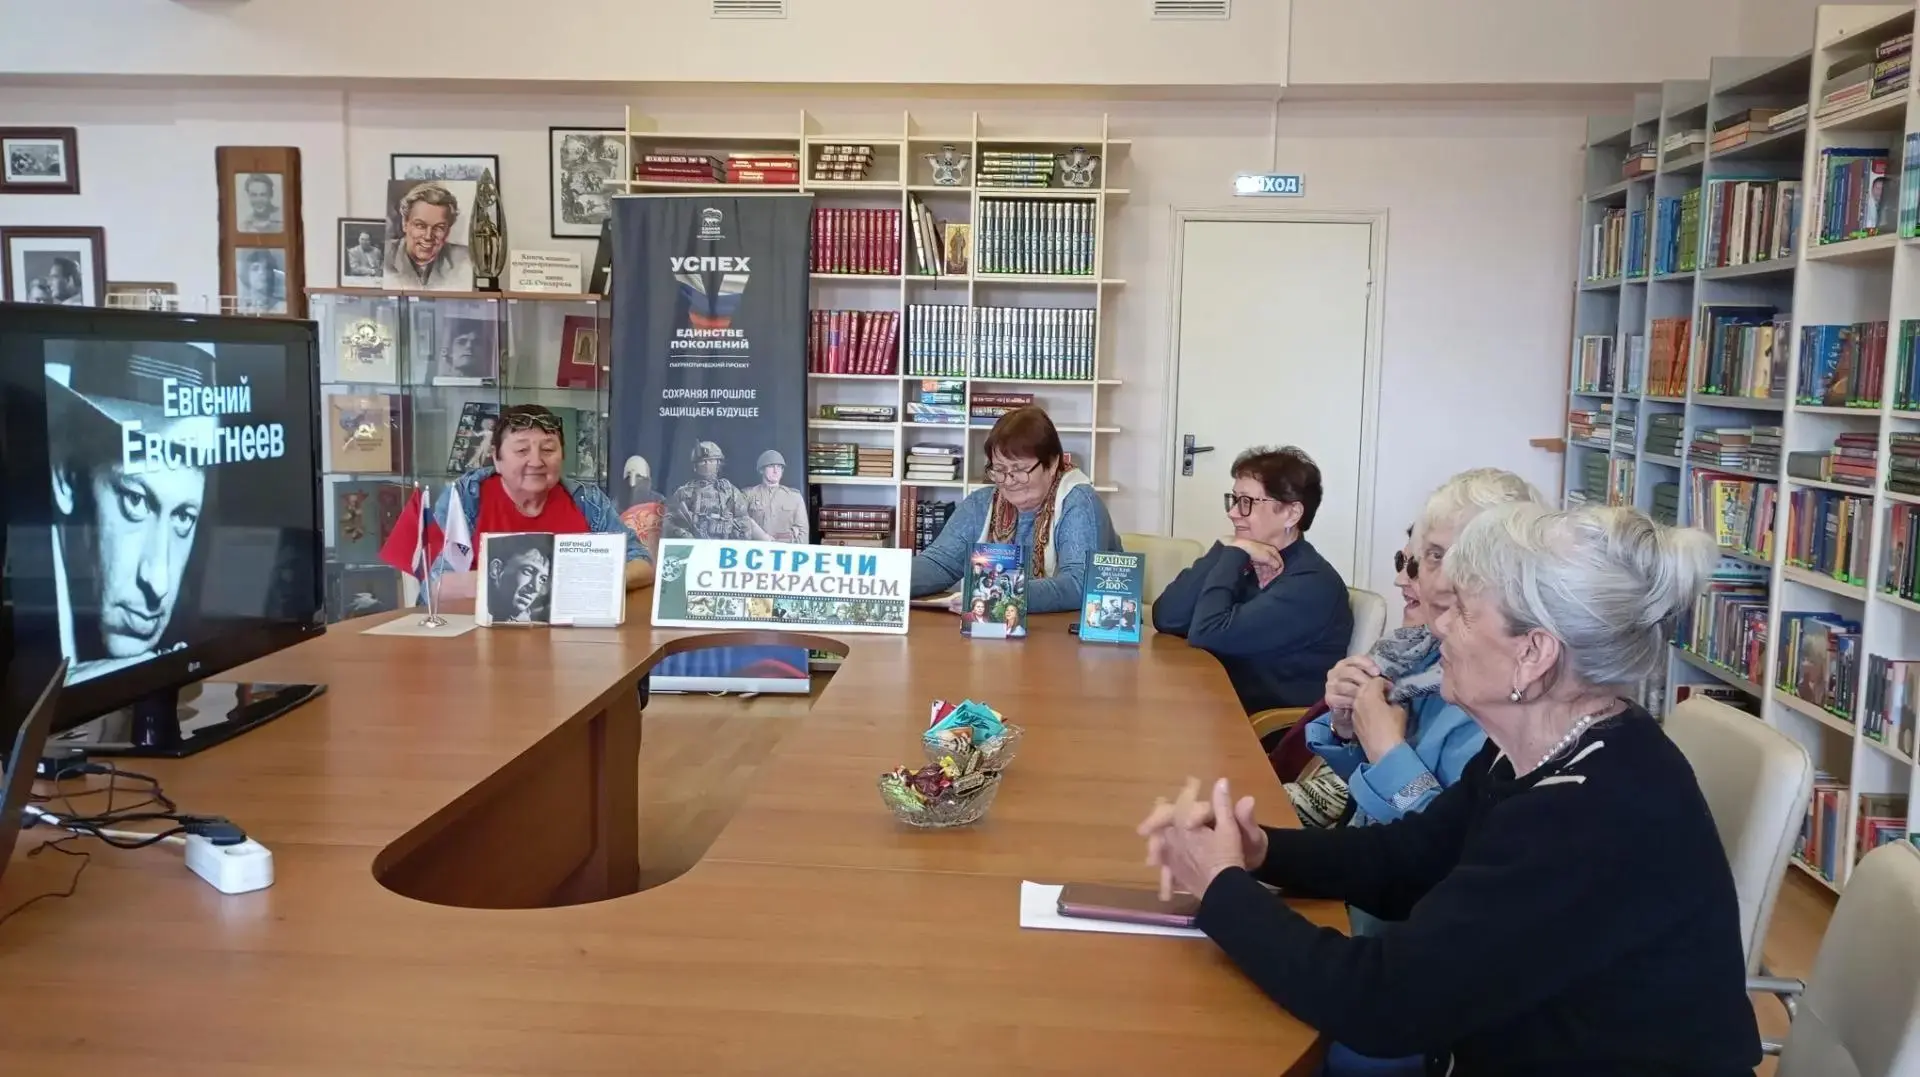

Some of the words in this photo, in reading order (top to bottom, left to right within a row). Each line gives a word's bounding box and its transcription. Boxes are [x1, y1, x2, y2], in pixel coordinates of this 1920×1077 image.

[1241, 177, 1297, 192] ХОД
[670, 256, 751, 272] УСПЕХ
[676, 328, 744, 338] ЕДИНСТВЕ
[670, 339, 749, 349] ПОКОЛЕНИЙ
[163, 375, 252, 417] Евгений
[662, 389, 709, 399] СОХРАНЯЯ
[710, 389, 757, 399] ПРОШЛОЕ
[659, 407, 714, 418] ЗАЩИЩАЕМ
[716, 407, 759, 418] БУДУЩЕЕ
[122, 420, 285, 474] Евстигнеев
[718, 547, 877, 576] ВСТРЕЧИ
[696, 570, 713, 588] С
[720, 571, 900, 596] ПРЕКРАСНЫМ
